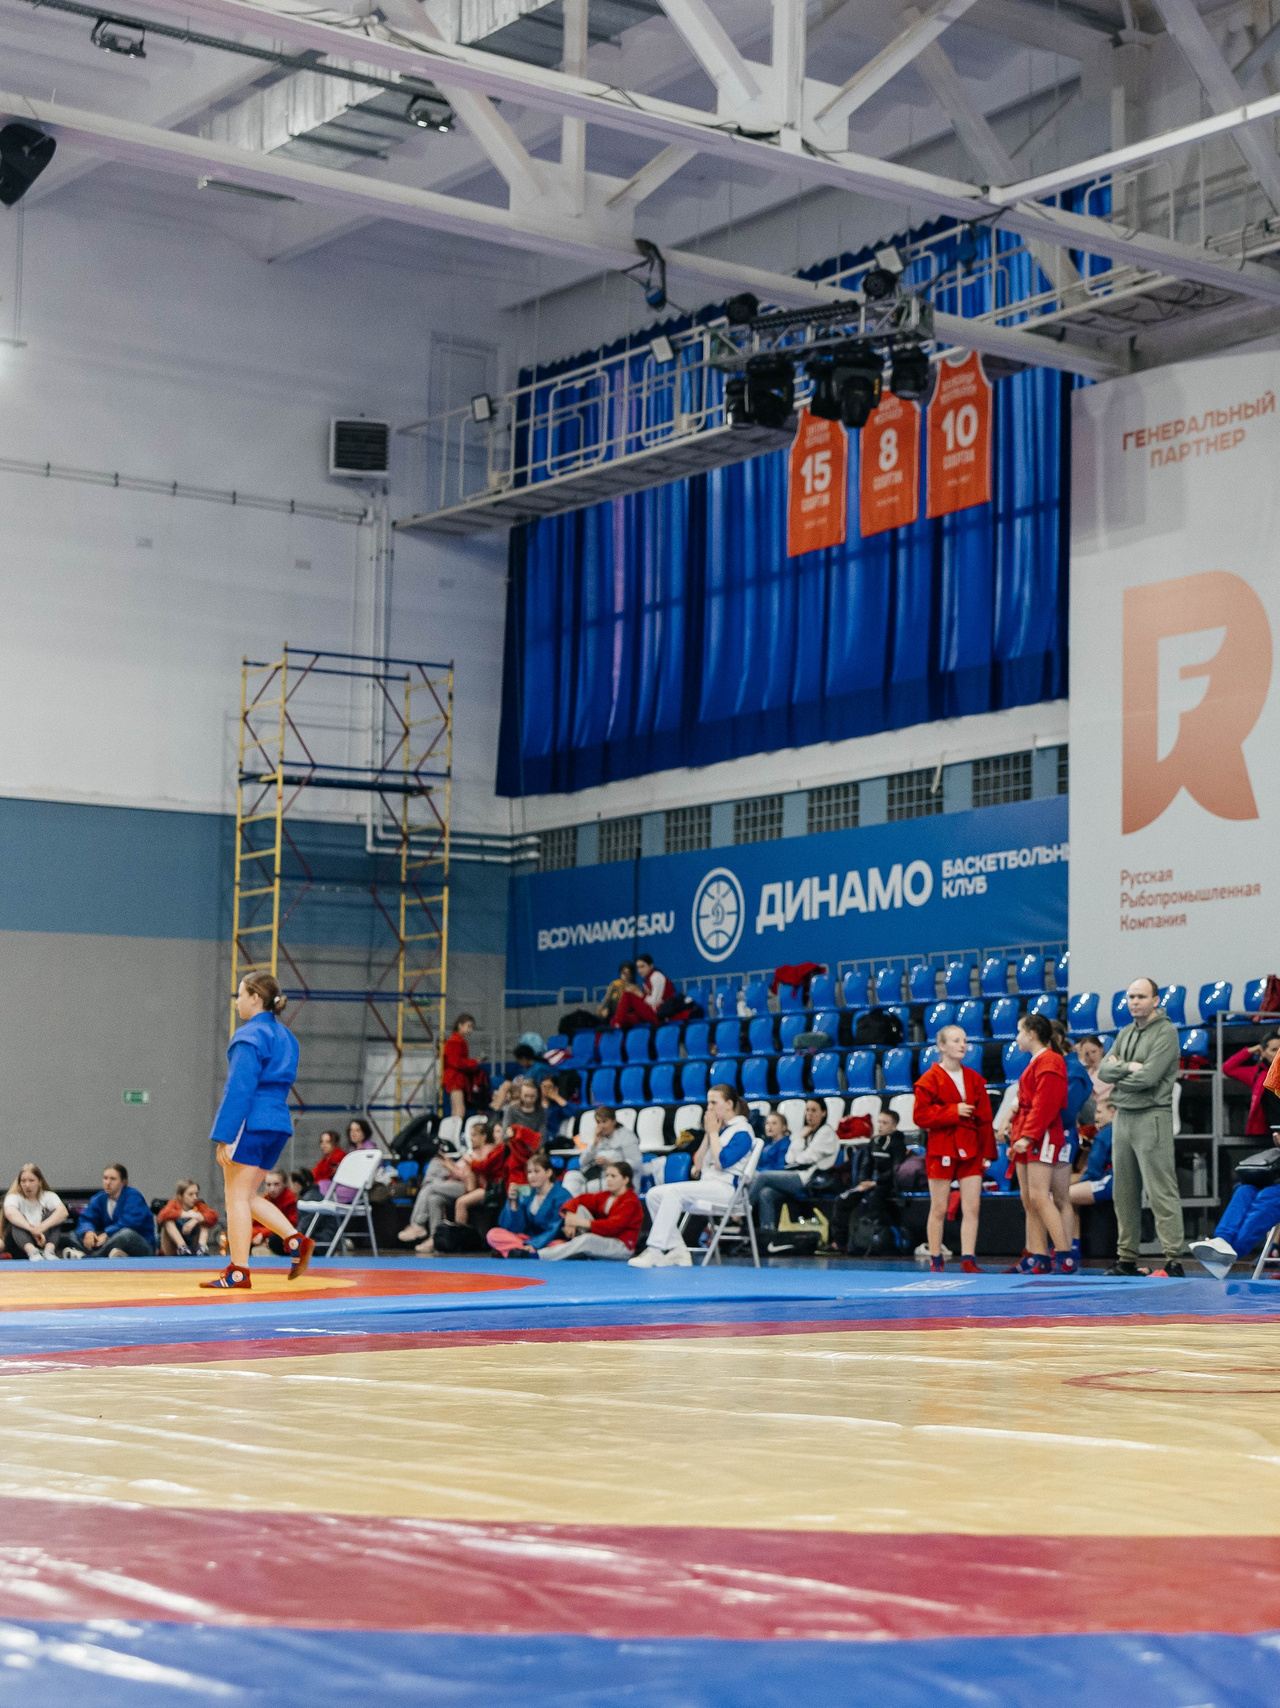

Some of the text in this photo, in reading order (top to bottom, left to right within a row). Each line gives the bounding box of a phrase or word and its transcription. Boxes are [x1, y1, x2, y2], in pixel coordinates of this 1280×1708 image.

[941, 404, 978, 452] 10
[1122, 390, 1276, 452] ГЕНЕРАЛЬНЫЙ
[878, 428, 898, 471] 8
[1150, 428, 1246, 468] ПАРТНЕР
[801, 450, 832, 495] 15
[756, 860, 933, 935] ДИНАМО
[942, 875, 988, 899] КЛУБ
[1120, 866, 1173, 888] Русская
[1120, 880, 1261, 911] Рыбопромышленная
[1120, 911, 1187, 932] Компания
